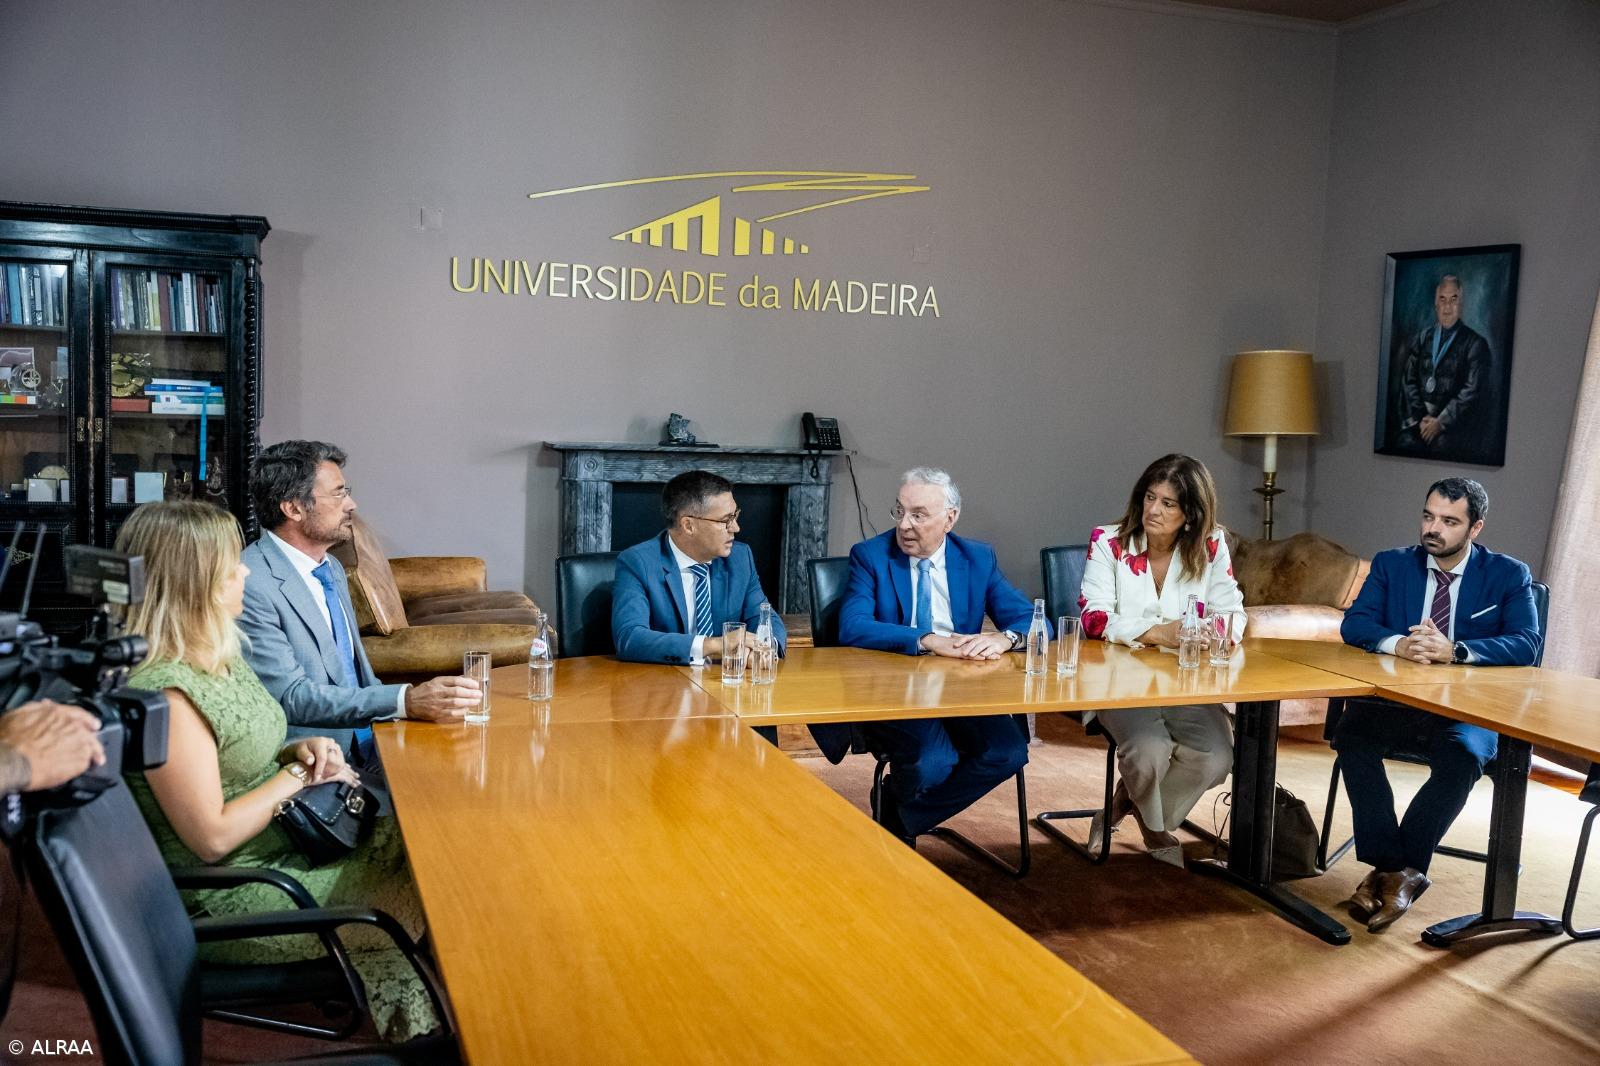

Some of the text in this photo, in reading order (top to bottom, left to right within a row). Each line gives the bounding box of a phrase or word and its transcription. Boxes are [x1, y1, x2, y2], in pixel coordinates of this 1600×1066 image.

[451, 256, 941, 318] UNIVERSIDADE da MADEIRA
